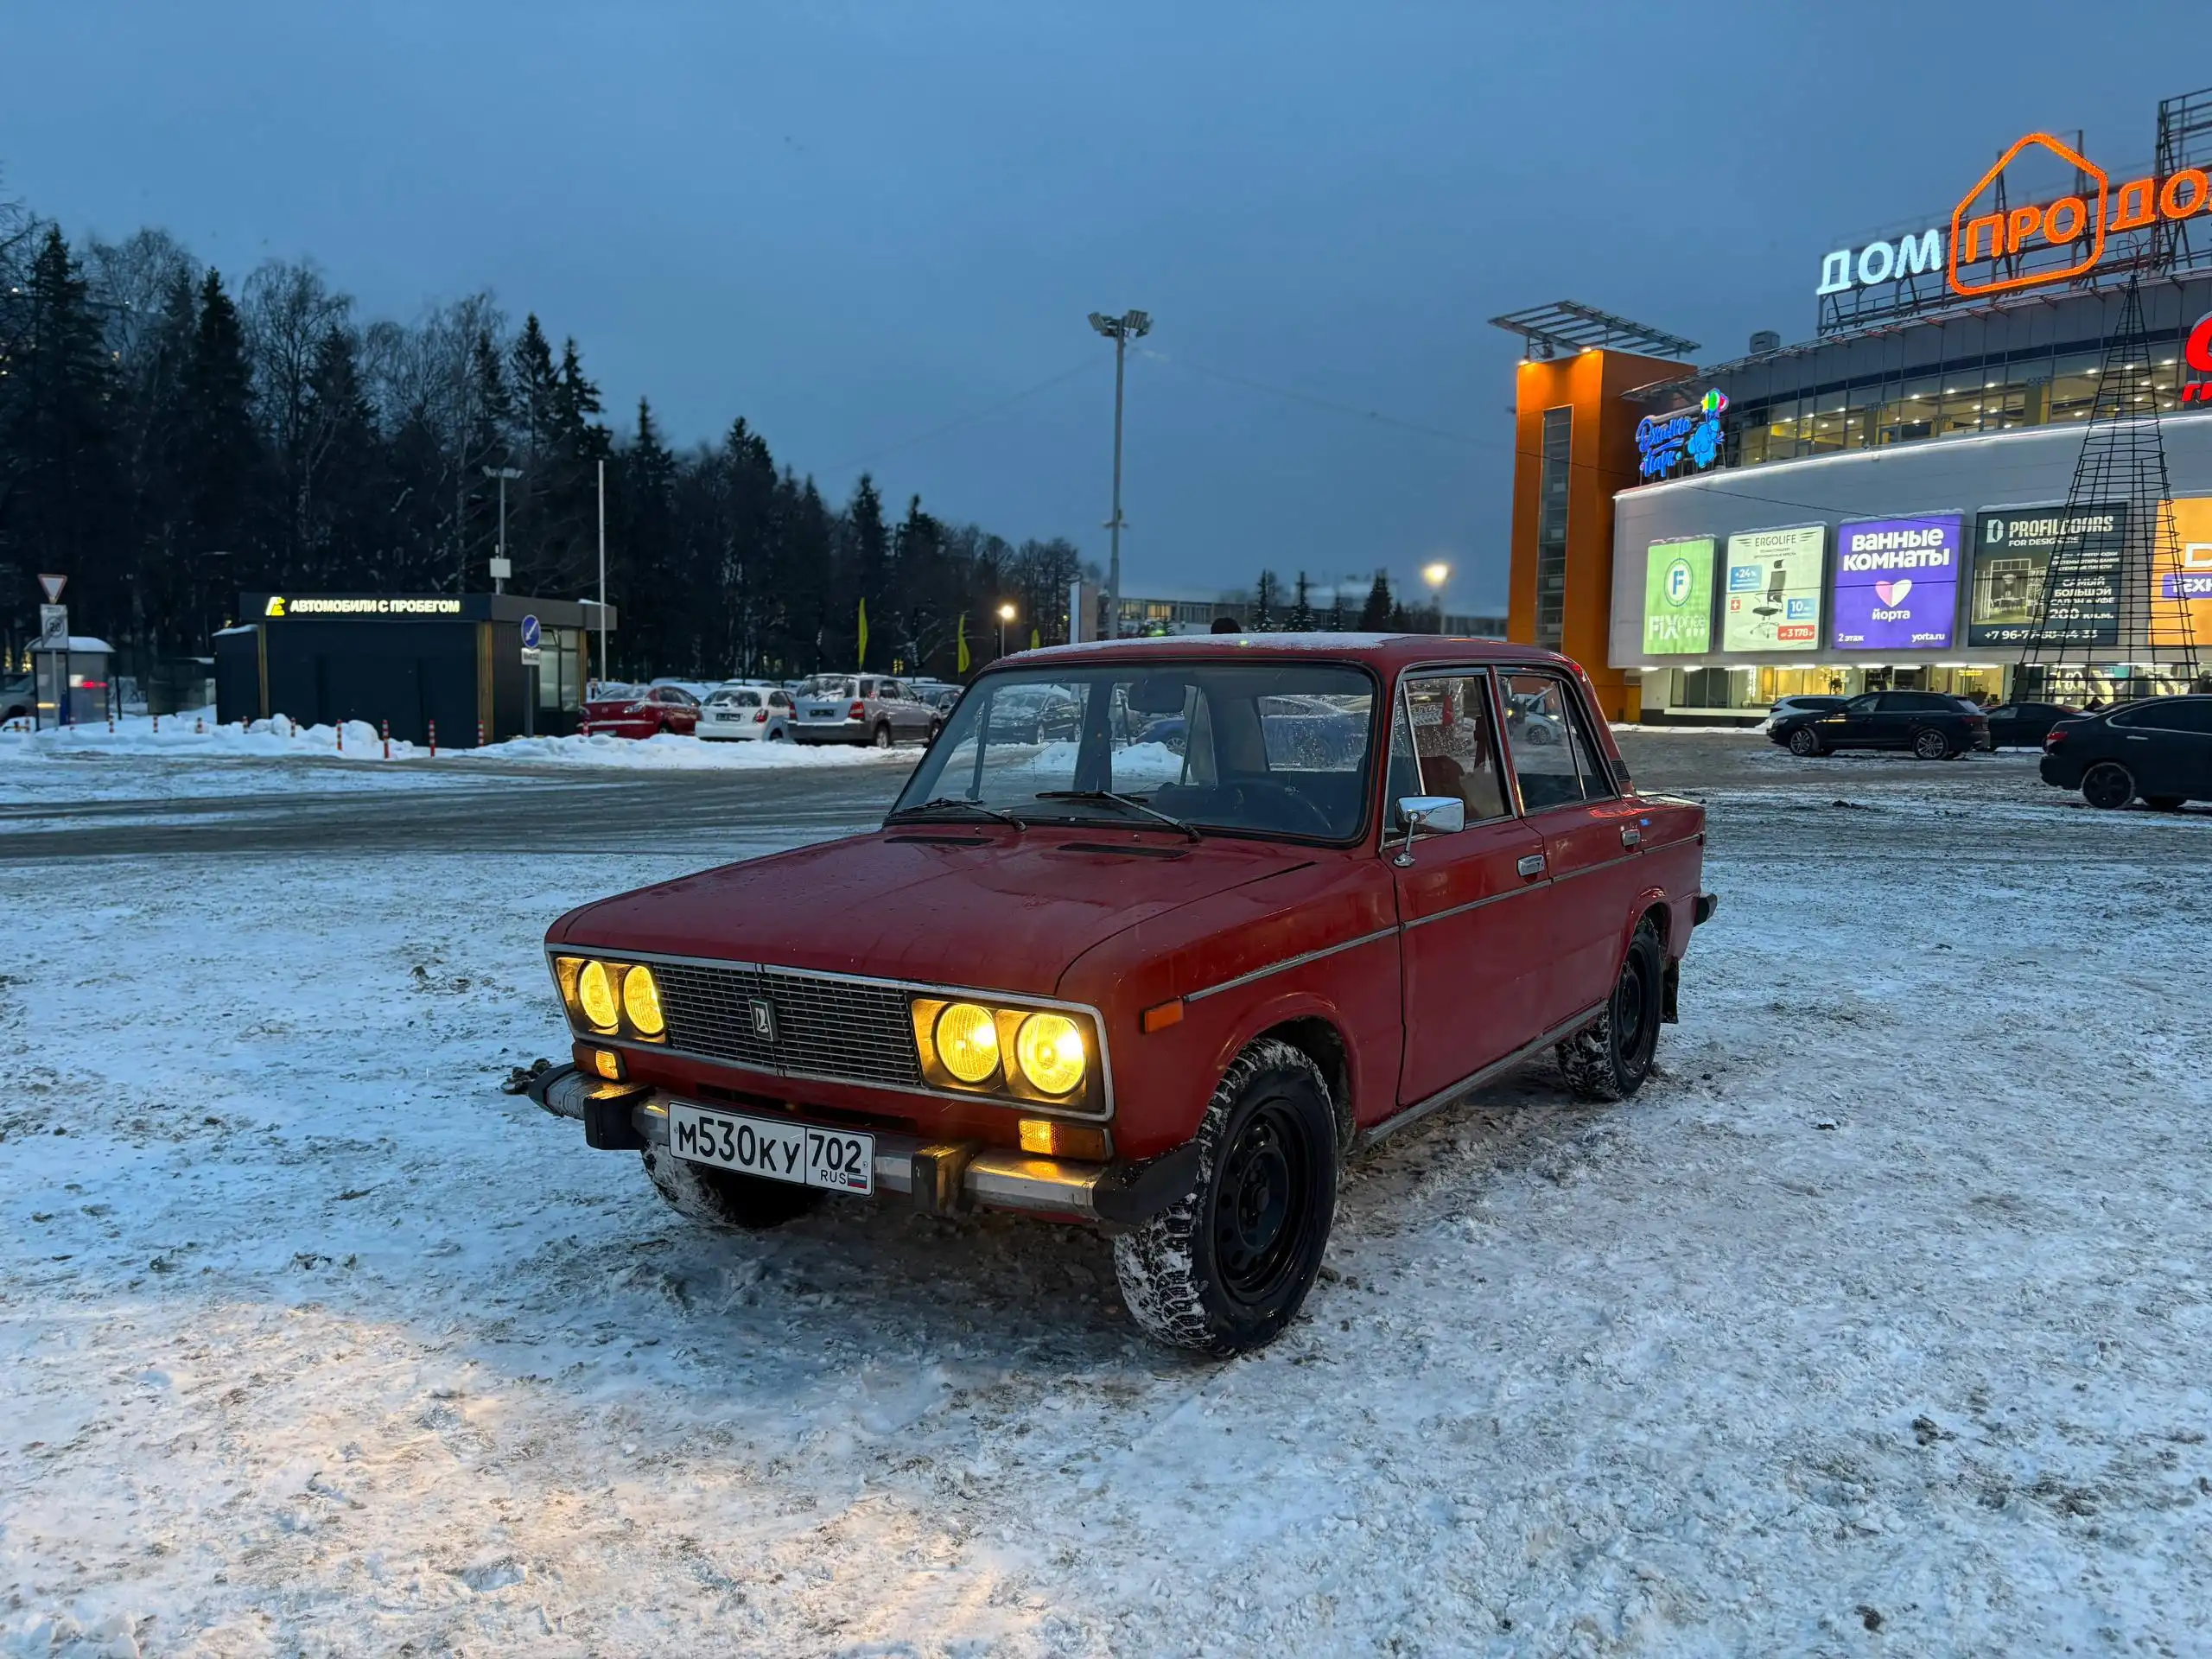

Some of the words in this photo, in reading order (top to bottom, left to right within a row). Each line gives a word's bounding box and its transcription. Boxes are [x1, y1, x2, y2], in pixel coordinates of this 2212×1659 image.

[1816, 228, 1942, 296] ДОМ
[1964, 196, 2088, 264] ПРО
[2109, 168, 2212, 232] ДО
[1755, 534, 1796, 547] ERGOLIFE
[1672, 570, 1684, 595] F
[289, 600, 377, 613] АВТОМОБИЛИ
[378, 600, 389, 613] С
[390, 600, 461, 613] ПРОБЕГОМ
[1790, 600, 1804, 613] 10
[1872, 608, 1910, 622] йорта
[1838, 632, 1845, 642] 2
[1911, 632, 1945, 643] yorta.ru
[678, 1116, 800, 1174] М530КУ
[809, 1134, 861, 1174] 702
[821, 1169, 847, 1185] RUS
